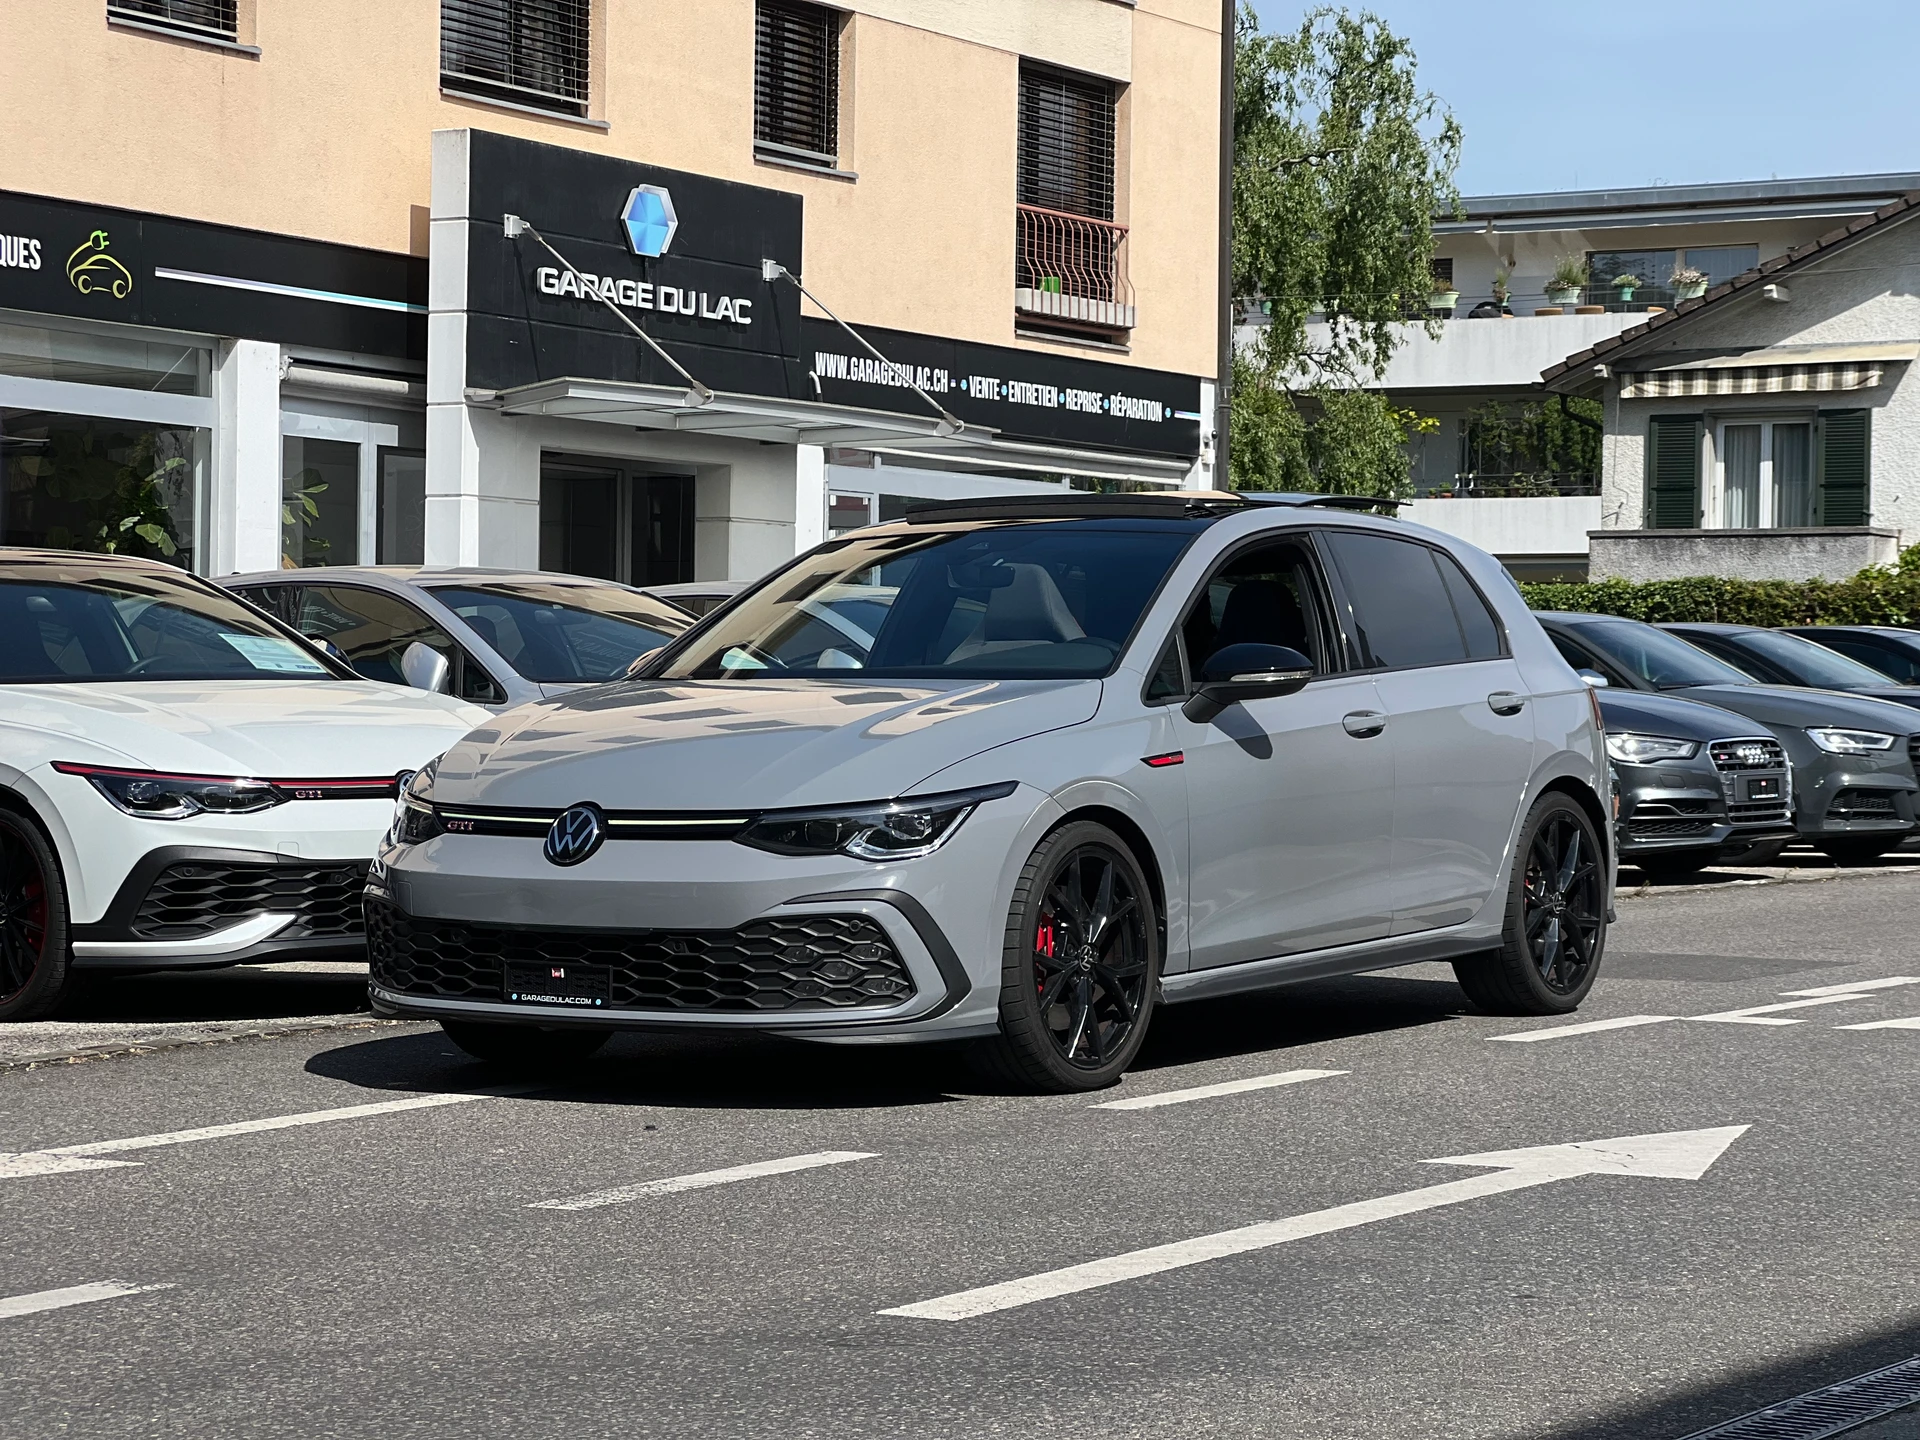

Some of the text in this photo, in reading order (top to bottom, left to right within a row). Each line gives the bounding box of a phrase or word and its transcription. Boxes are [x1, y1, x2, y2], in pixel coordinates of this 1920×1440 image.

[537, 267, 752, 325] GARAGE DU LAC
[815, 351, 1163, 422] WWW.GARAGEDULAC.CH VENTE ENTRETIEN REPRISE RÉPARATION
[295, 789, 323, 799] GTI
[447, 820, 475, 831] GTI
[549, 806, 599, 862] VW
[521, 993, 592, 1005] GARAGEDULAC.COM
